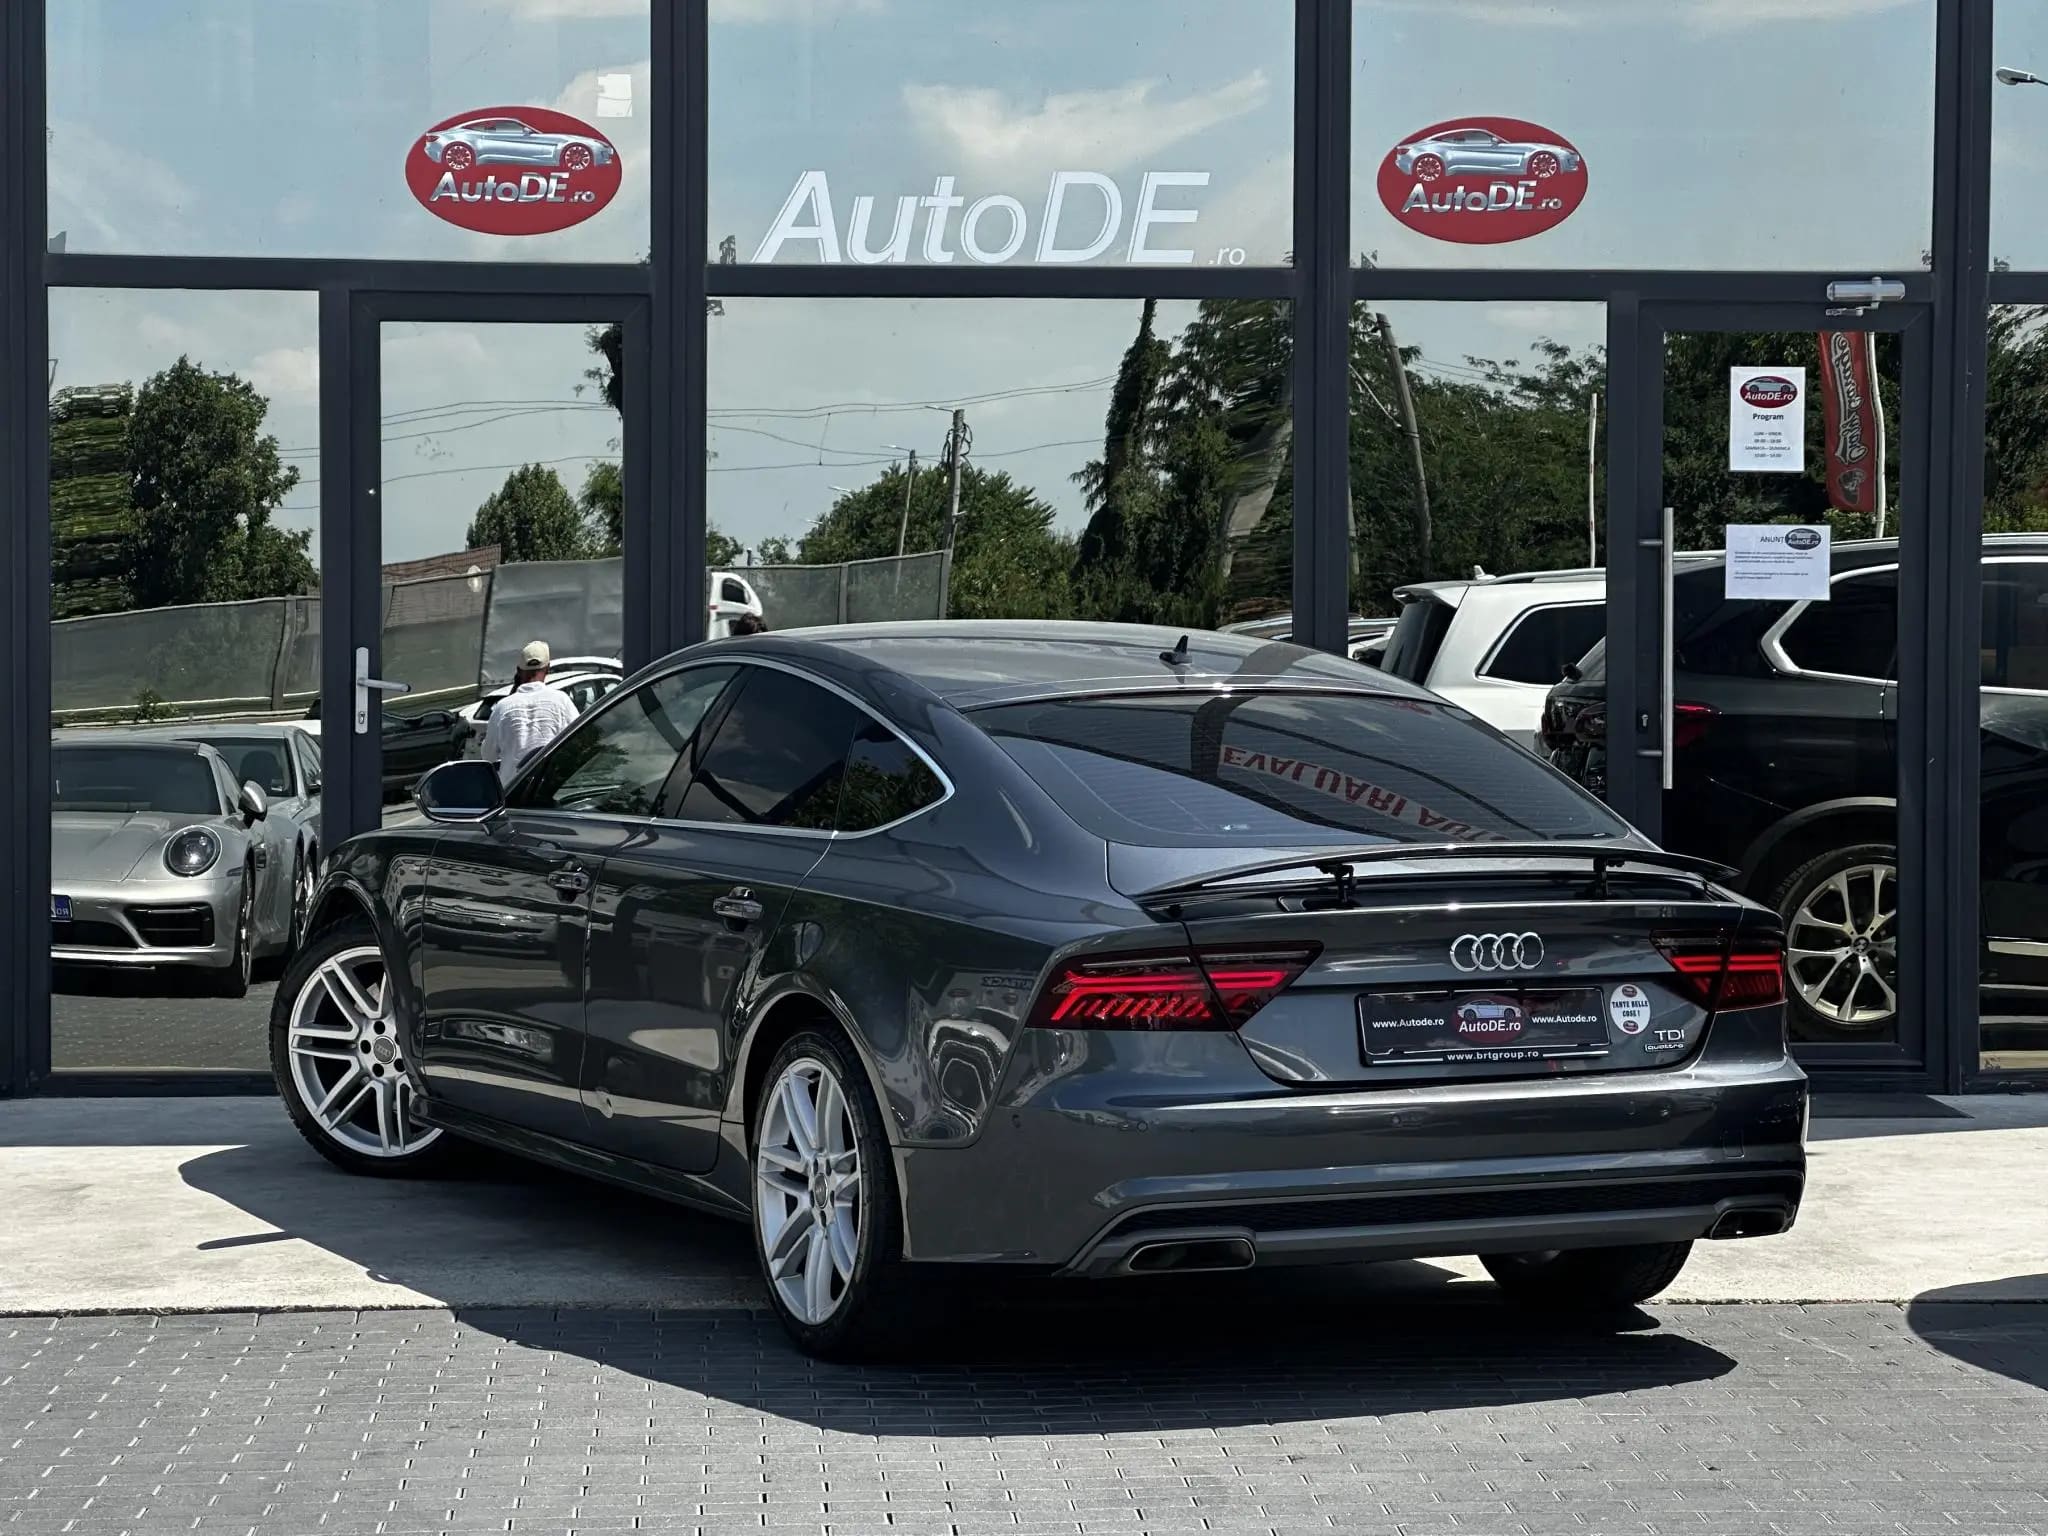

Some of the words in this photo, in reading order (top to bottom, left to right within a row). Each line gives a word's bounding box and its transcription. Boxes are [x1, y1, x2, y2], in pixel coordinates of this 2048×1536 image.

[1744, 391, 1794, 401] AutoDE.ro
[1752, 413, 1784, 421] Program
[1372, 1017, 1445, 1029] www.Autode.ro
[1531, 1014, 1598, 1024] www.Autode.ro
[1458, 1019, 1521, 1033] AutoDE.ro
[1654, 1029, 1685, 1041] TDI
[1646, 1043, 1684, 1051] quattro
[1447, 1050, 1539, 1061] www.brtgroup.ro
